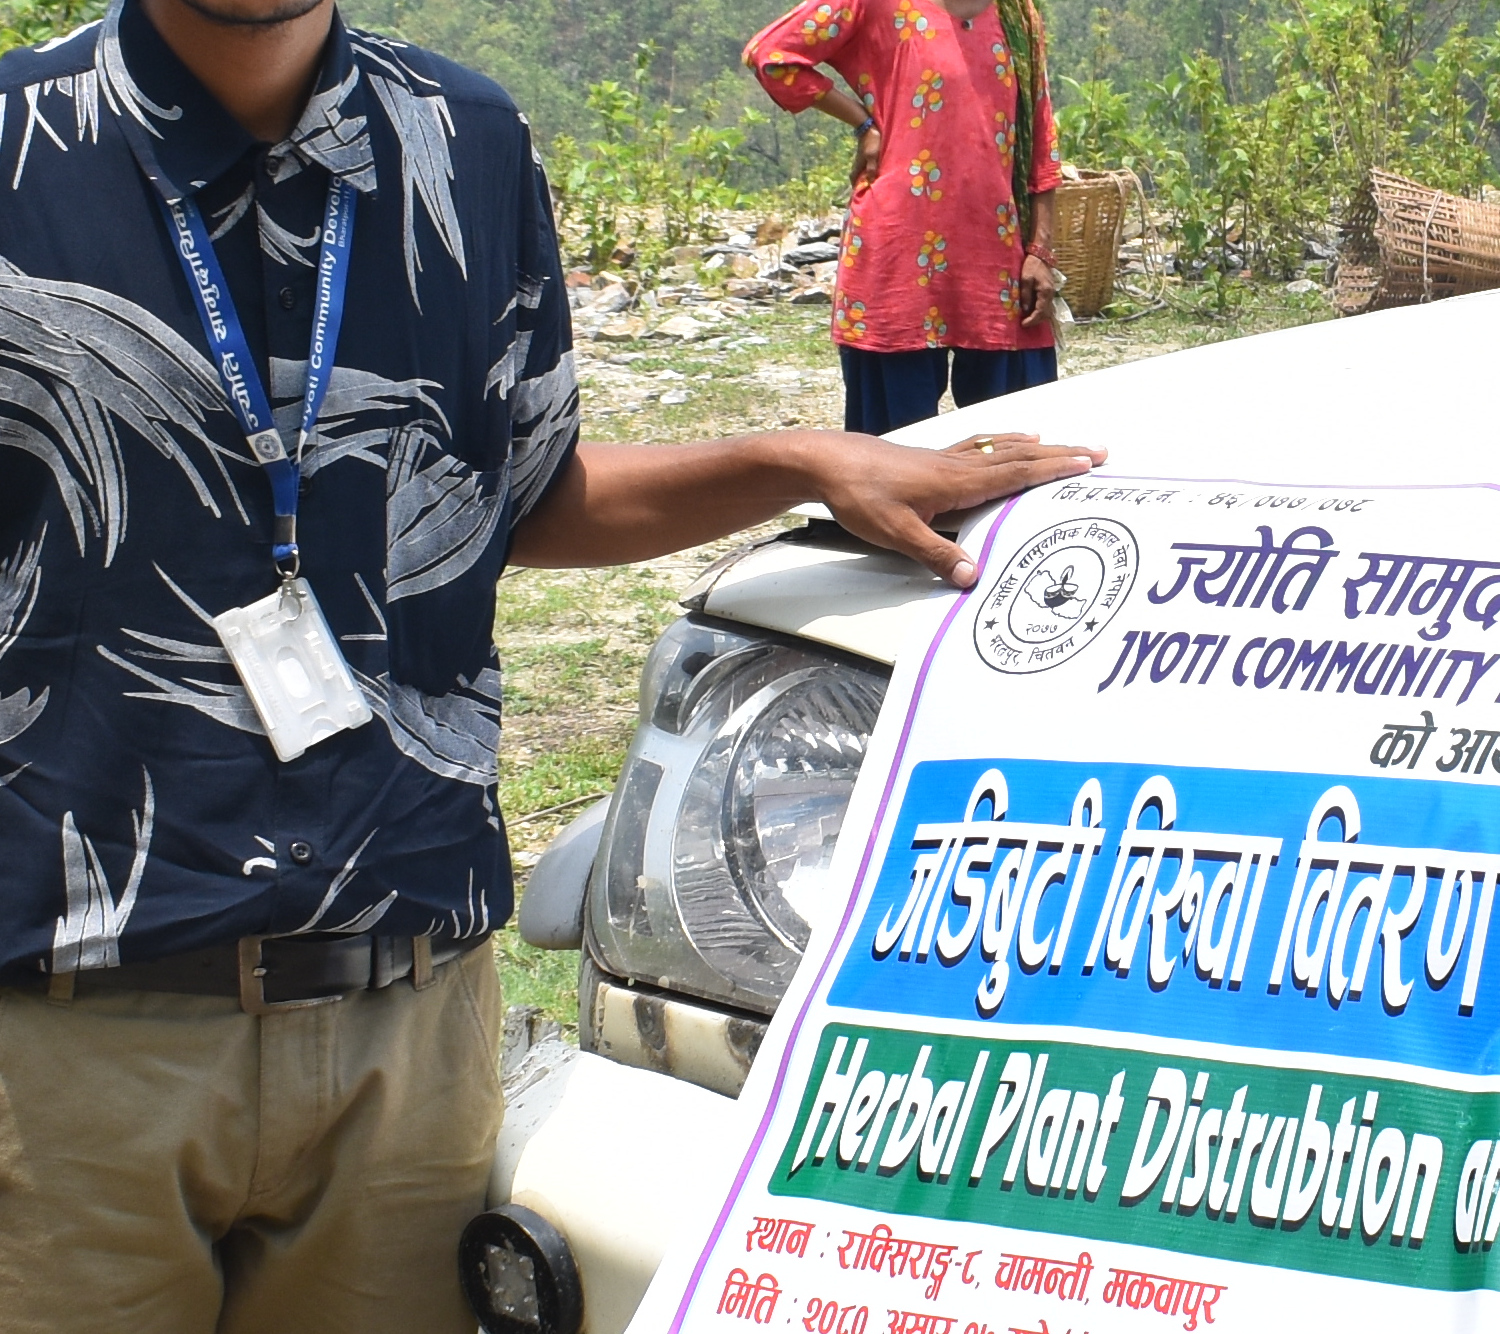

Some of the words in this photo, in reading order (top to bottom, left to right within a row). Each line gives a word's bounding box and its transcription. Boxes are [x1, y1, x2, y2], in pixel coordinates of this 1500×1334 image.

[311, 250, 336, 368] Community
[221, 352, 259, 430] ज्योति
[1147, 525, 1341, 614] ज्योति
[1097, 630, 1233, 694] JYOTI
[1369, 710, 1439, 770] को
[871, 767, 1106, 1019] जडिबुटी
[788, 1035, 990, 1183] Herbal
[968, 1051, 1126, 1195] Plant
[1118, 1065, 1444, 1249] Distrubtion
[716, 1267, 782, 1325] मिति
[746, 1216, 816, 1259] स्थान
[1102, 1267, 1229, 1331] मकवापुर
